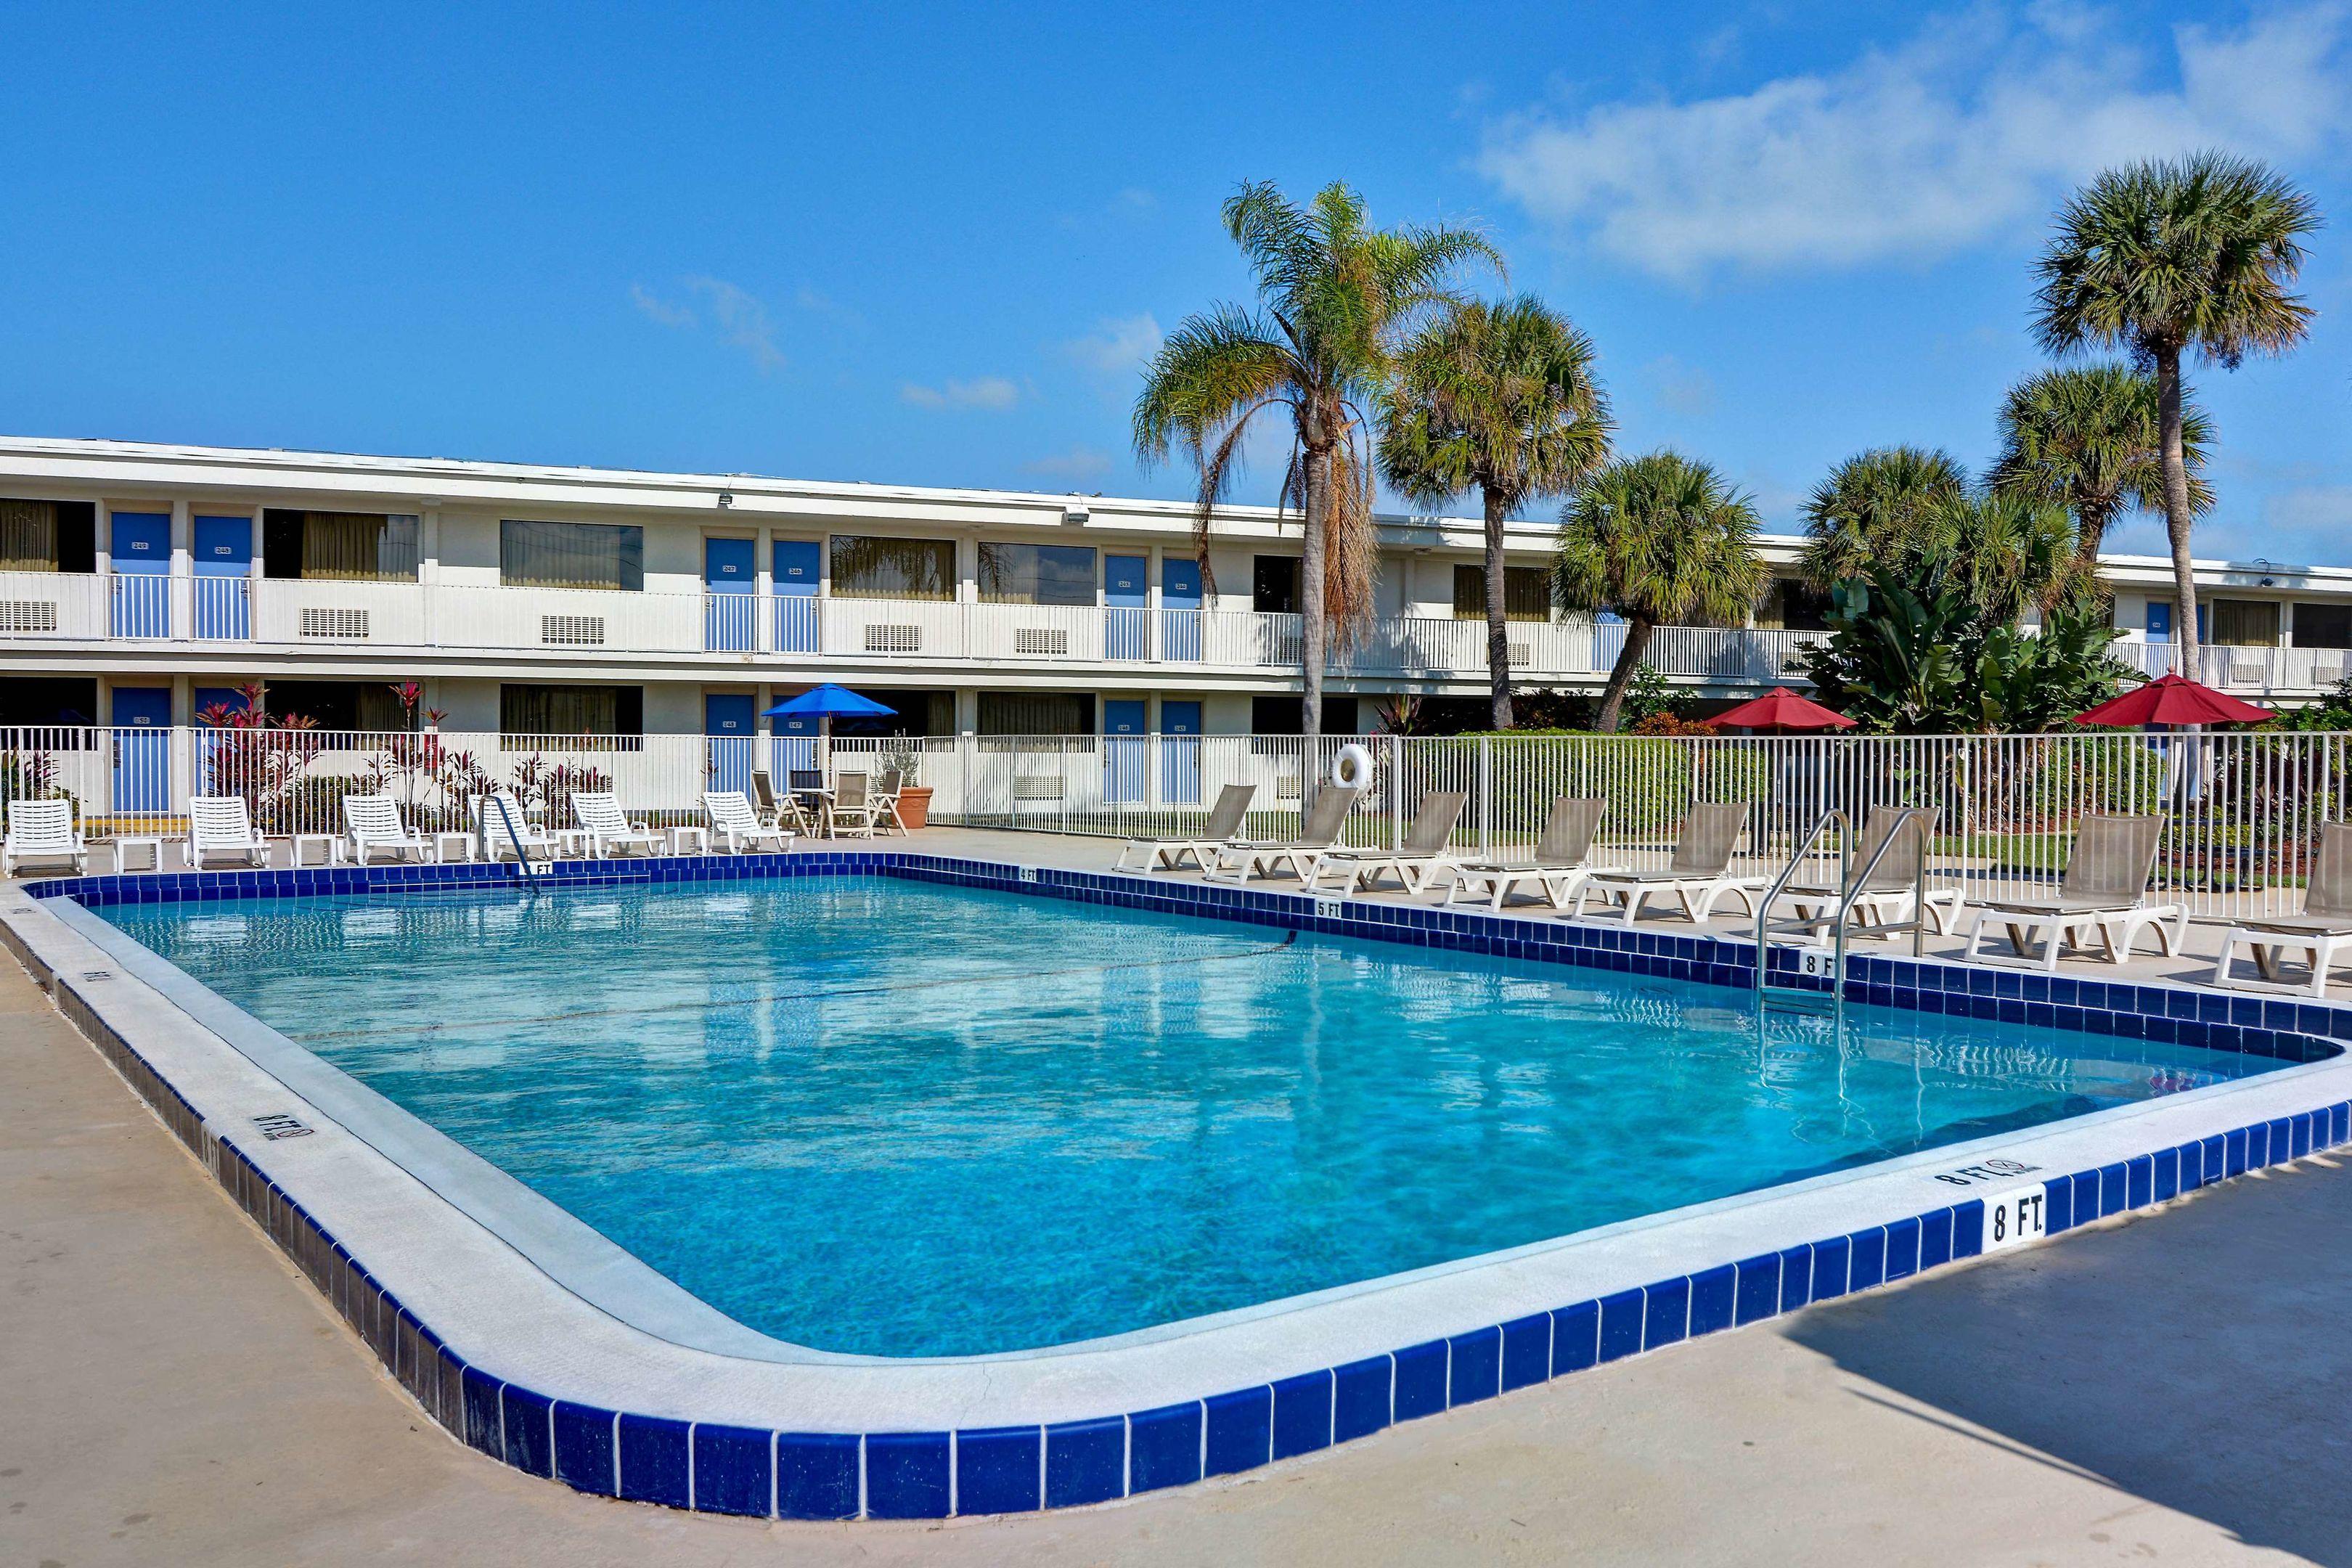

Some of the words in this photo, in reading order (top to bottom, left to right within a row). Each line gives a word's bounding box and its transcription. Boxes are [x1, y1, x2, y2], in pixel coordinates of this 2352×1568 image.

[1021, 869, 1026, 880] 4
[1318, 902, 1324, 916] 5
[1807, 955, 1816, 973] 8
[1824, 957, 1837, 976] F
[1934, 1175, 1972, 1185] 8
[1994, 1204, 2006, 1242] 8
[2017, 1194, 2043, 1236] FT.
